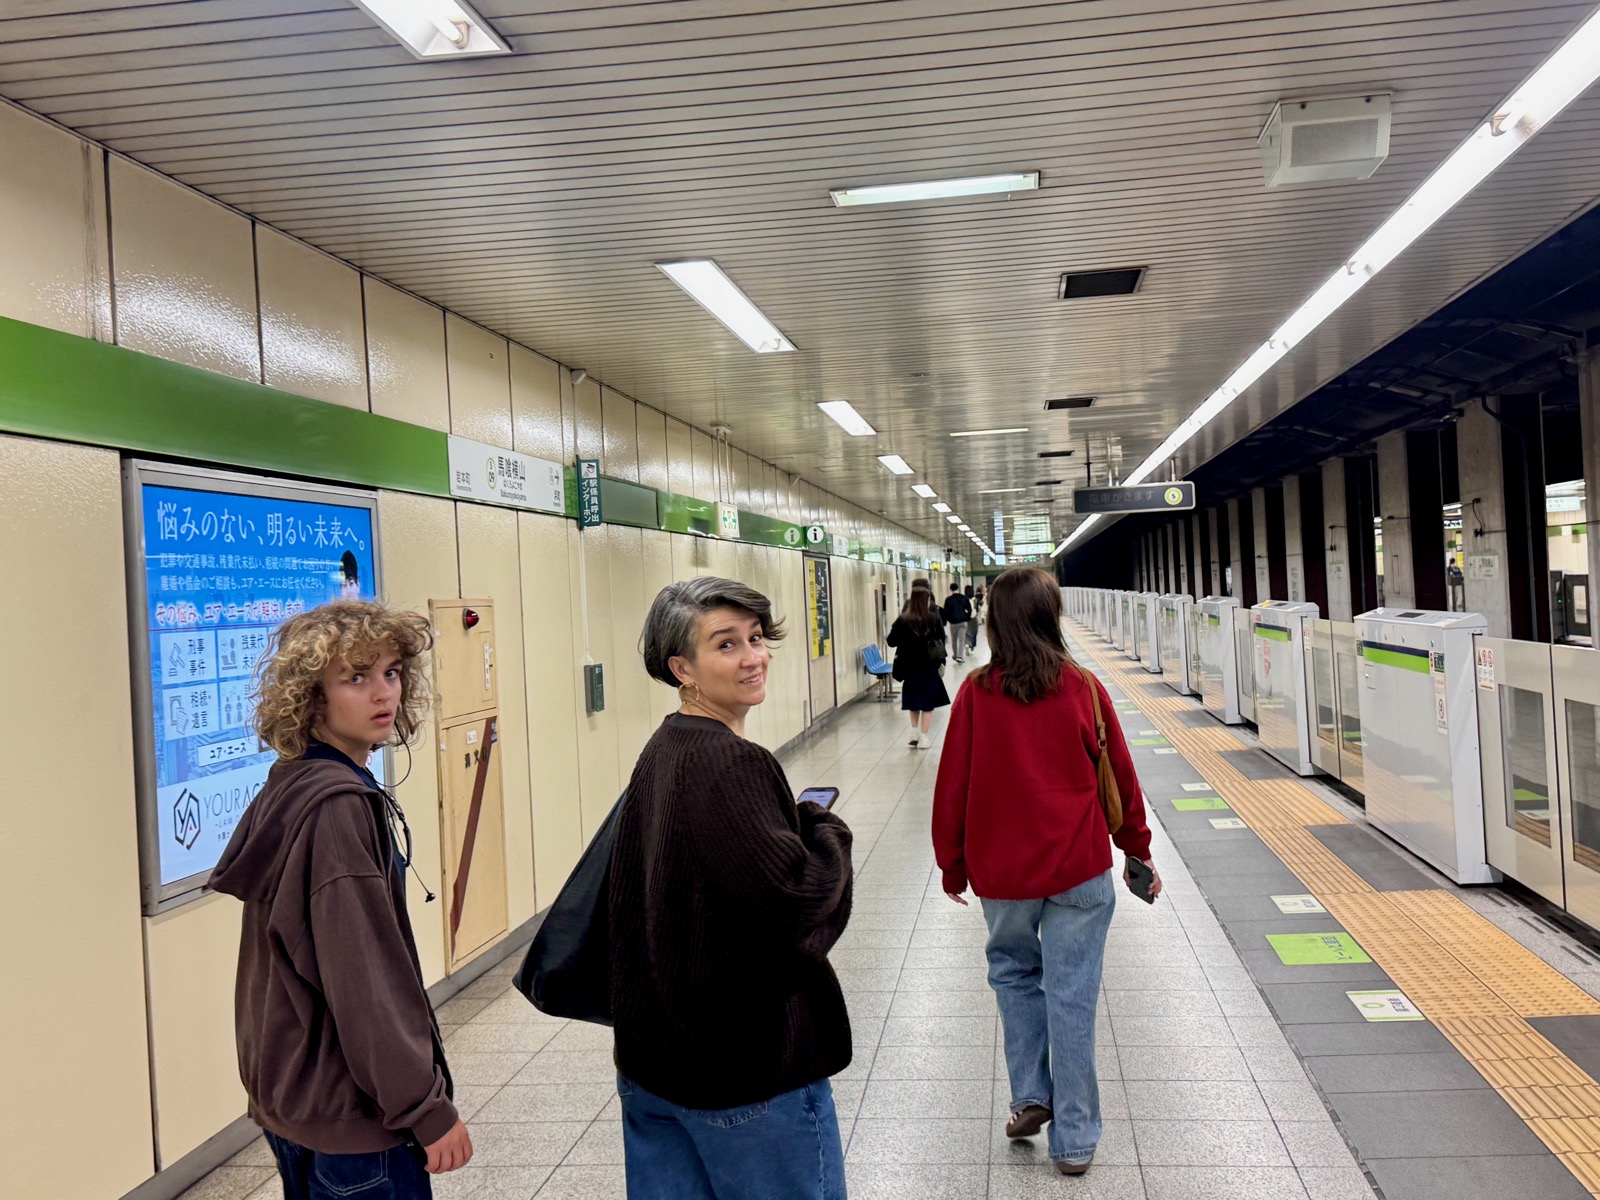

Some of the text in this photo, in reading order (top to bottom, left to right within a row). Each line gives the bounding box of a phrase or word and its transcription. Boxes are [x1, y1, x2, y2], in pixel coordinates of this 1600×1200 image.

[498, 456, 525, 481] 馬喰横山
[581, 479, 590, 523] インターホン
[588, 478, 600, 522] 駅係員呼出
[157, 501, 365, 551] 悩みのない、明るい未来へ。
[188, 638, 205, 655] 刑事
[241, 634, 264, 650] 残業代
[189, 659, 206, 676] 事件
[210, 742, 247, 759] ユア・エース
